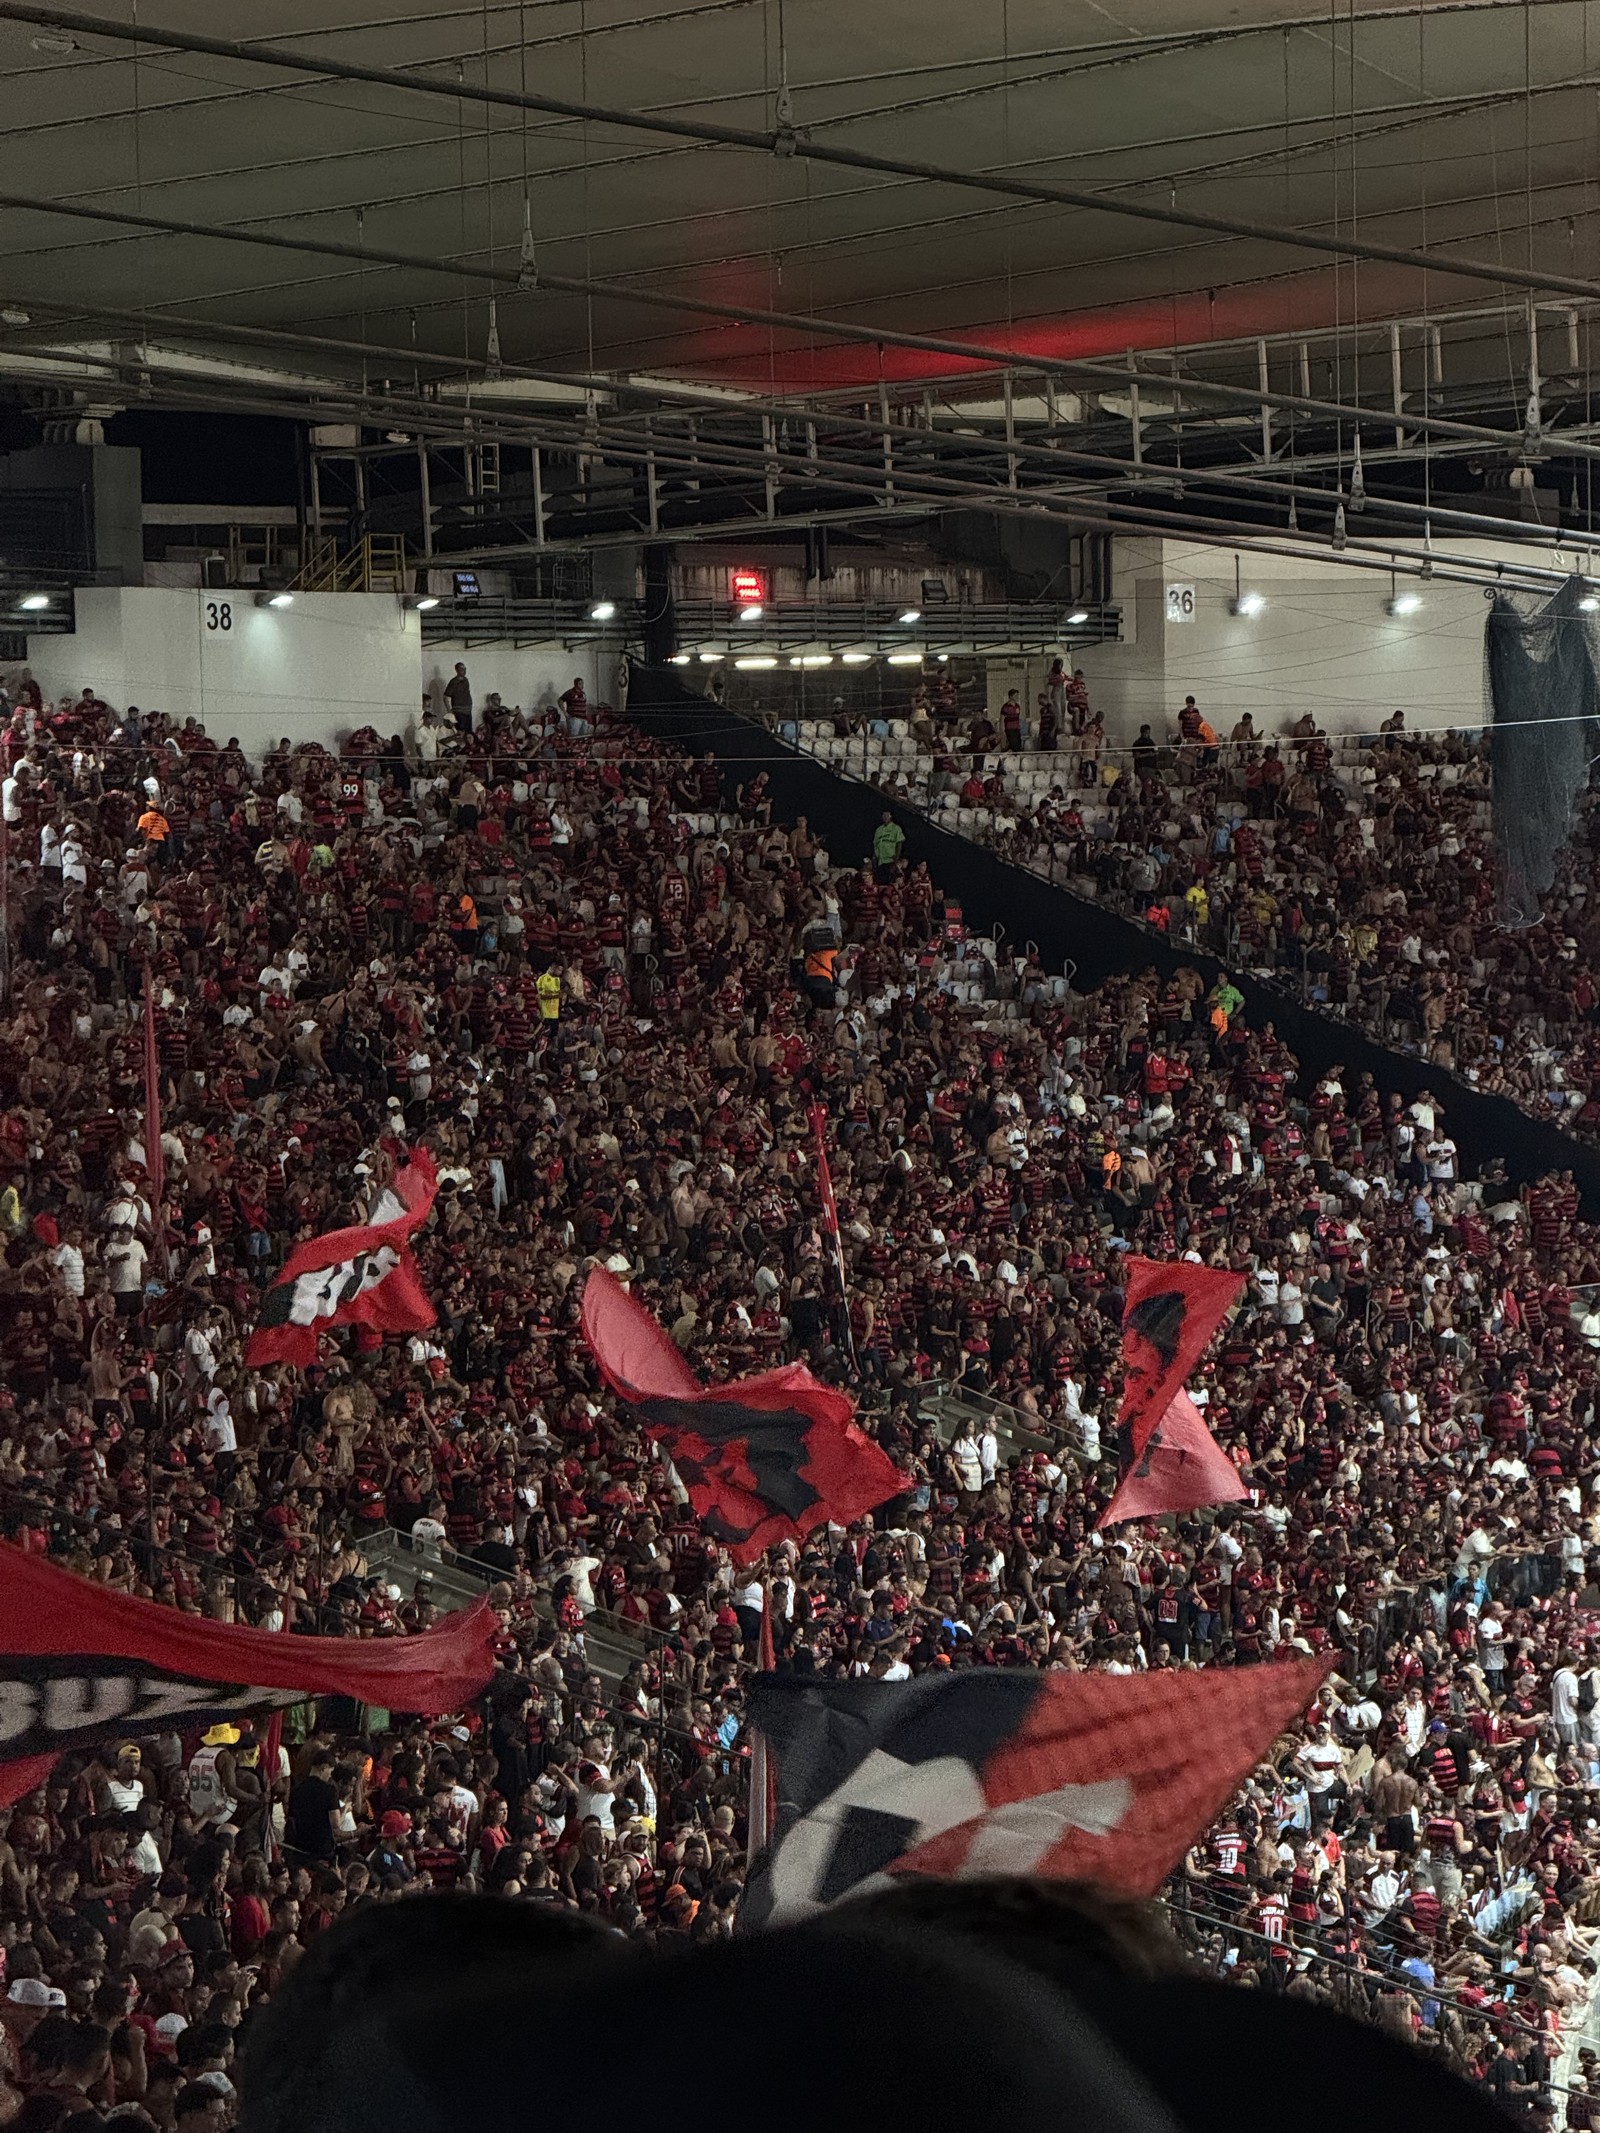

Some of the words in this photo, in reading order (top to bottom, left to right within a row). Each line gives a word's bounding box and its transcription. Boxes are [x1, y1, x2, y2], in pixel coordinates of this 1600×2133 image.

[1169, 590, 1193, 614] 36
[206, 602, 232, 631] 38
[343, 783, 359, 797] 99
[1262, 1916, 1283, 1942] 10
